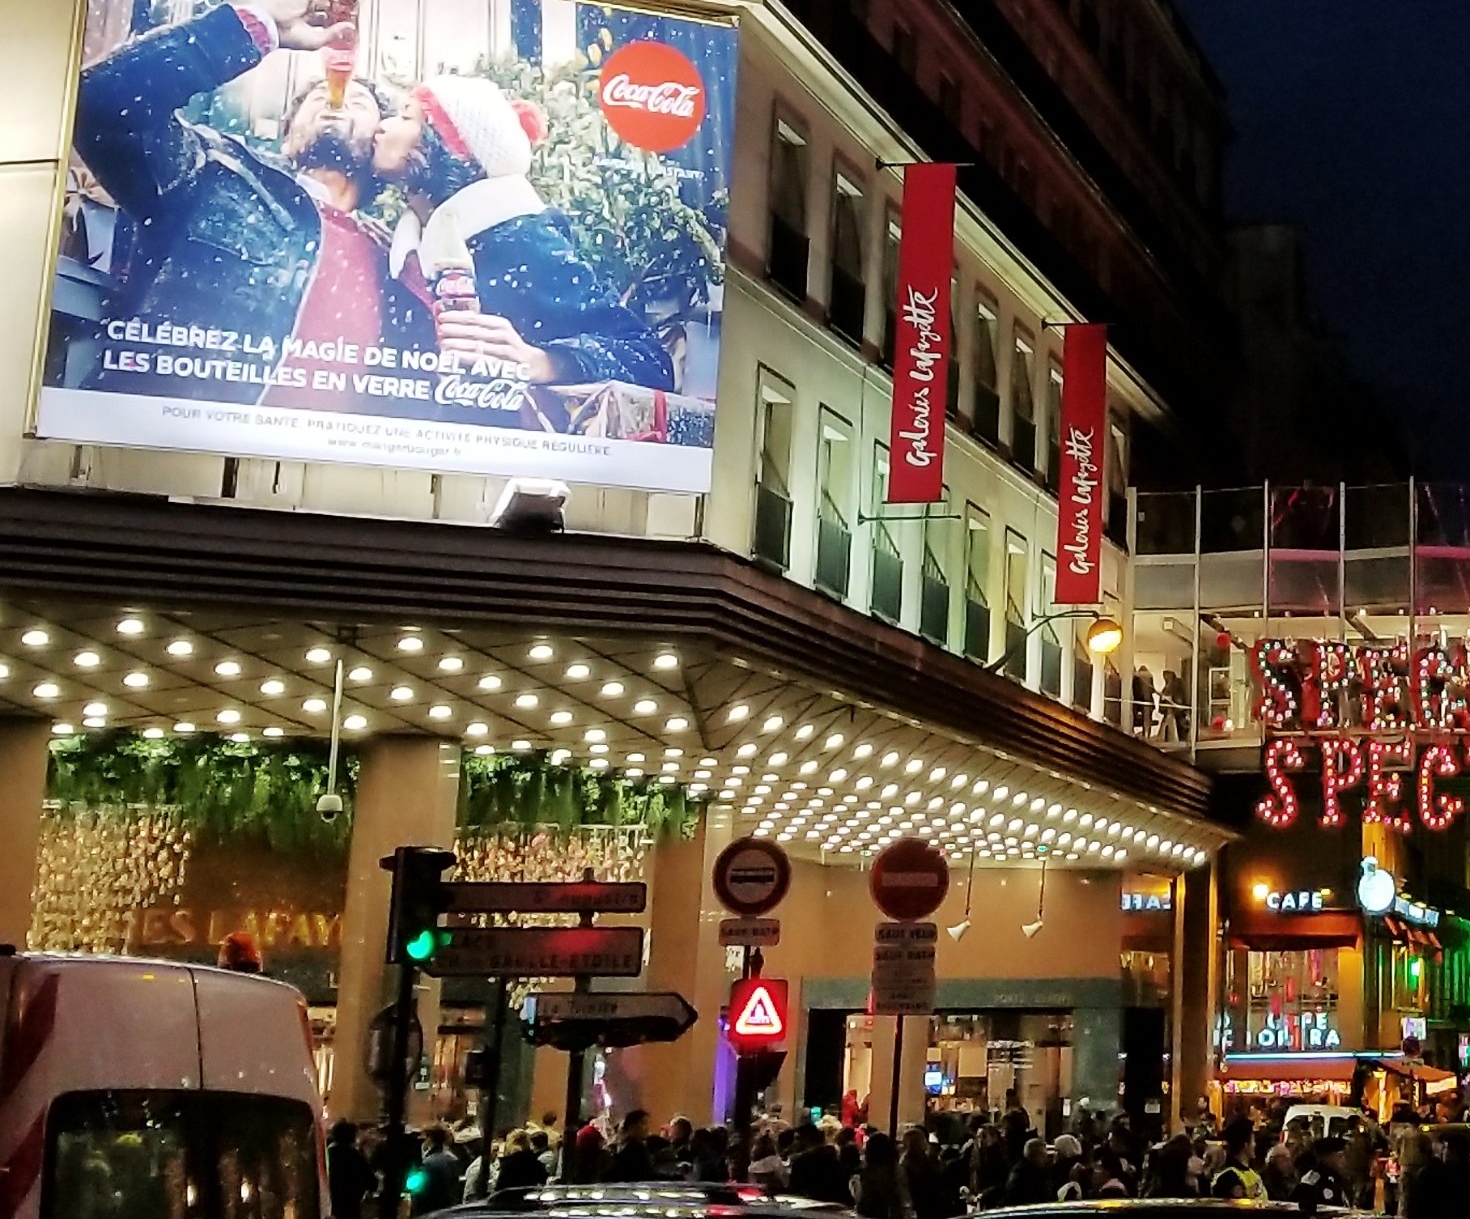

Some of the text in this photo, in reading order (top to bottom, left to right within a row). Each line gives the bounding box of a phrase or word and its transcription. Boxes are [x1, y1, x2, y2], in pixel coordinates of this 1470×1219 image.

[103, 349, 150, 373] LES
[156, 354, 307, 389] BOUTEILLES
[313, 372, 346, 393] EN
[352, 374, 430, 401] VERRE
[106, 317, 238, 352] CÉLÉBREZ
[242, 333, 274, 357] LA
[365, 348, 397, 369] DE
[471, 360, 531, 381] AVEC
[899, 285, 939, 468] Galeries Lafayette
[161, 405, 201, 420] POUR
[206, 410, 251, 425] VOTRE
[306, 418, 382, 435] PRATIQUEZ
[475, 434, 539, 450] PHYSIQUE
[1064, 426, 1096, 575] Galeries Lafayette
